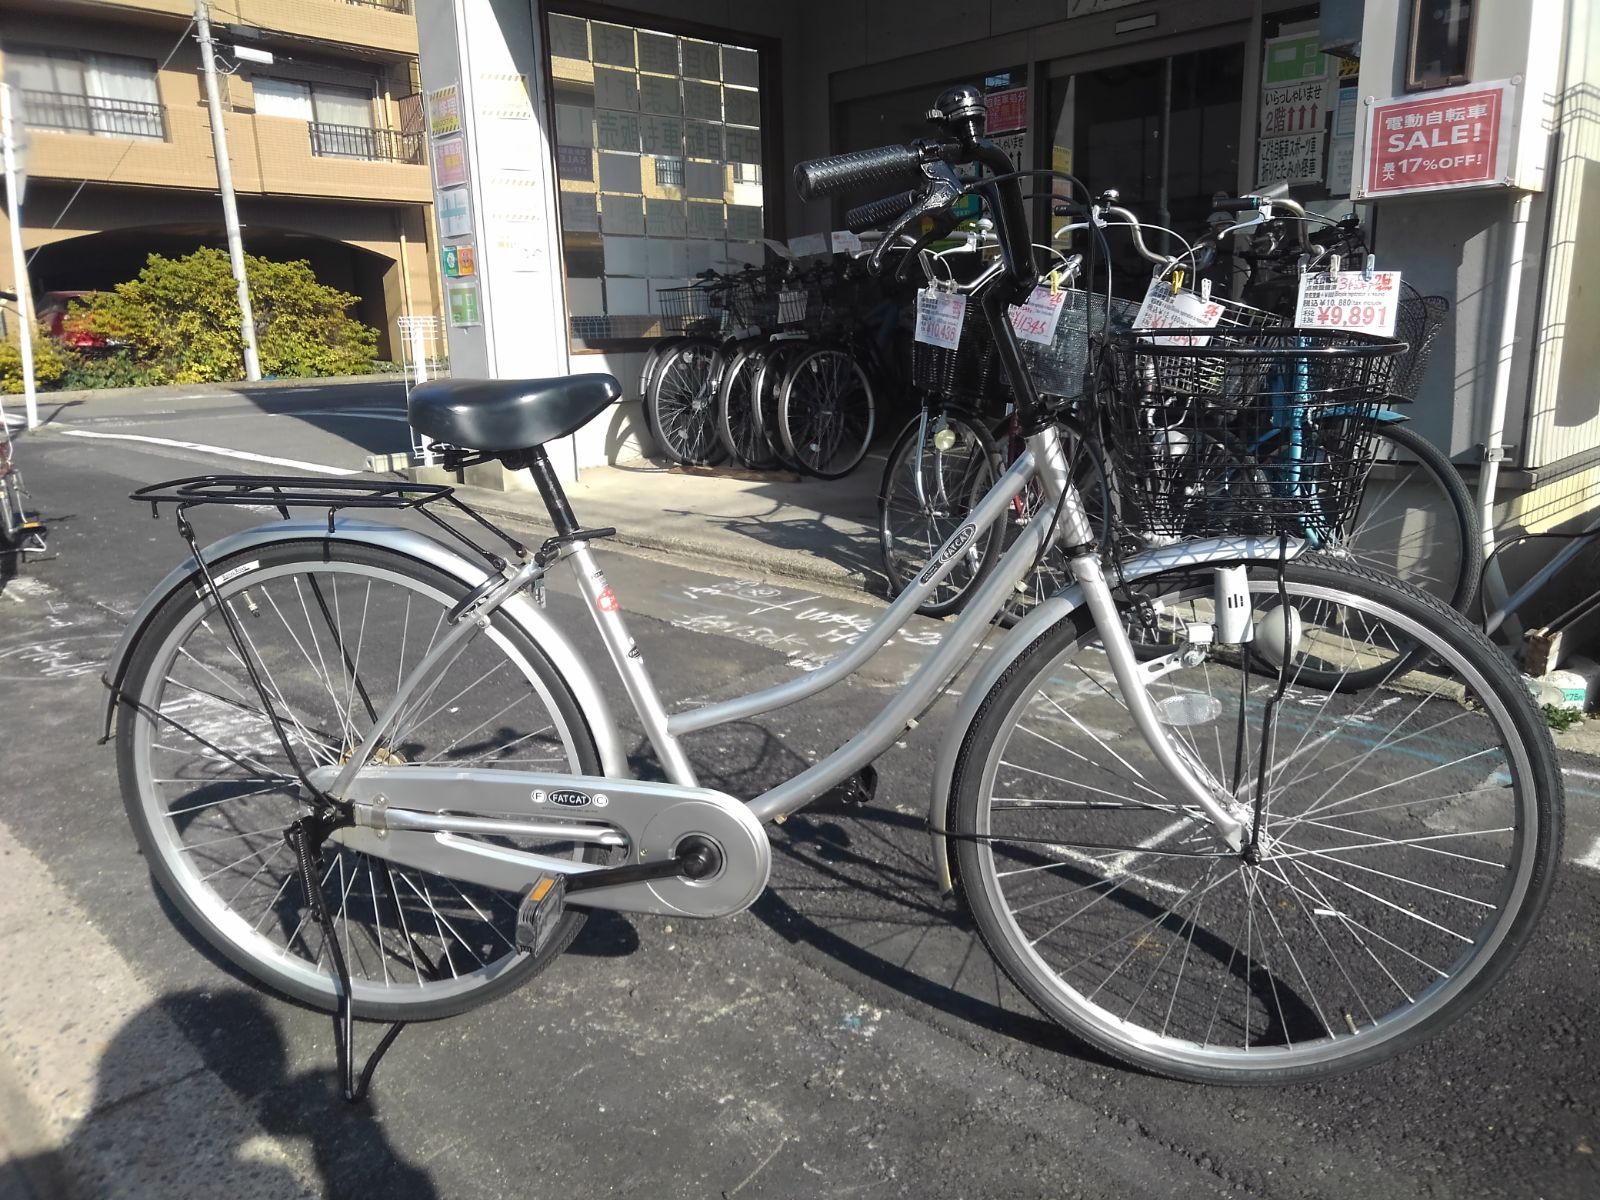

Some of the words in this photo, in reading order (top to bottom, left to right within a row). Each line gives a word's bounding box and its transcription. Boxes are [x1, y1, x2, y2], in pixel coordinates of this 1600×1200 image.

[1265, 84, 1322, 106] いらっしゃいませ
[1265, 106, 1286, 133] 2階
[1385, 104, 1488, 131] 電動自転車
[1387, 122, 1482, 153] SALE!
[1398, 153, 1483, 174] 17%OFF!
[1318, 306, 1387, 326] ¥9,891
